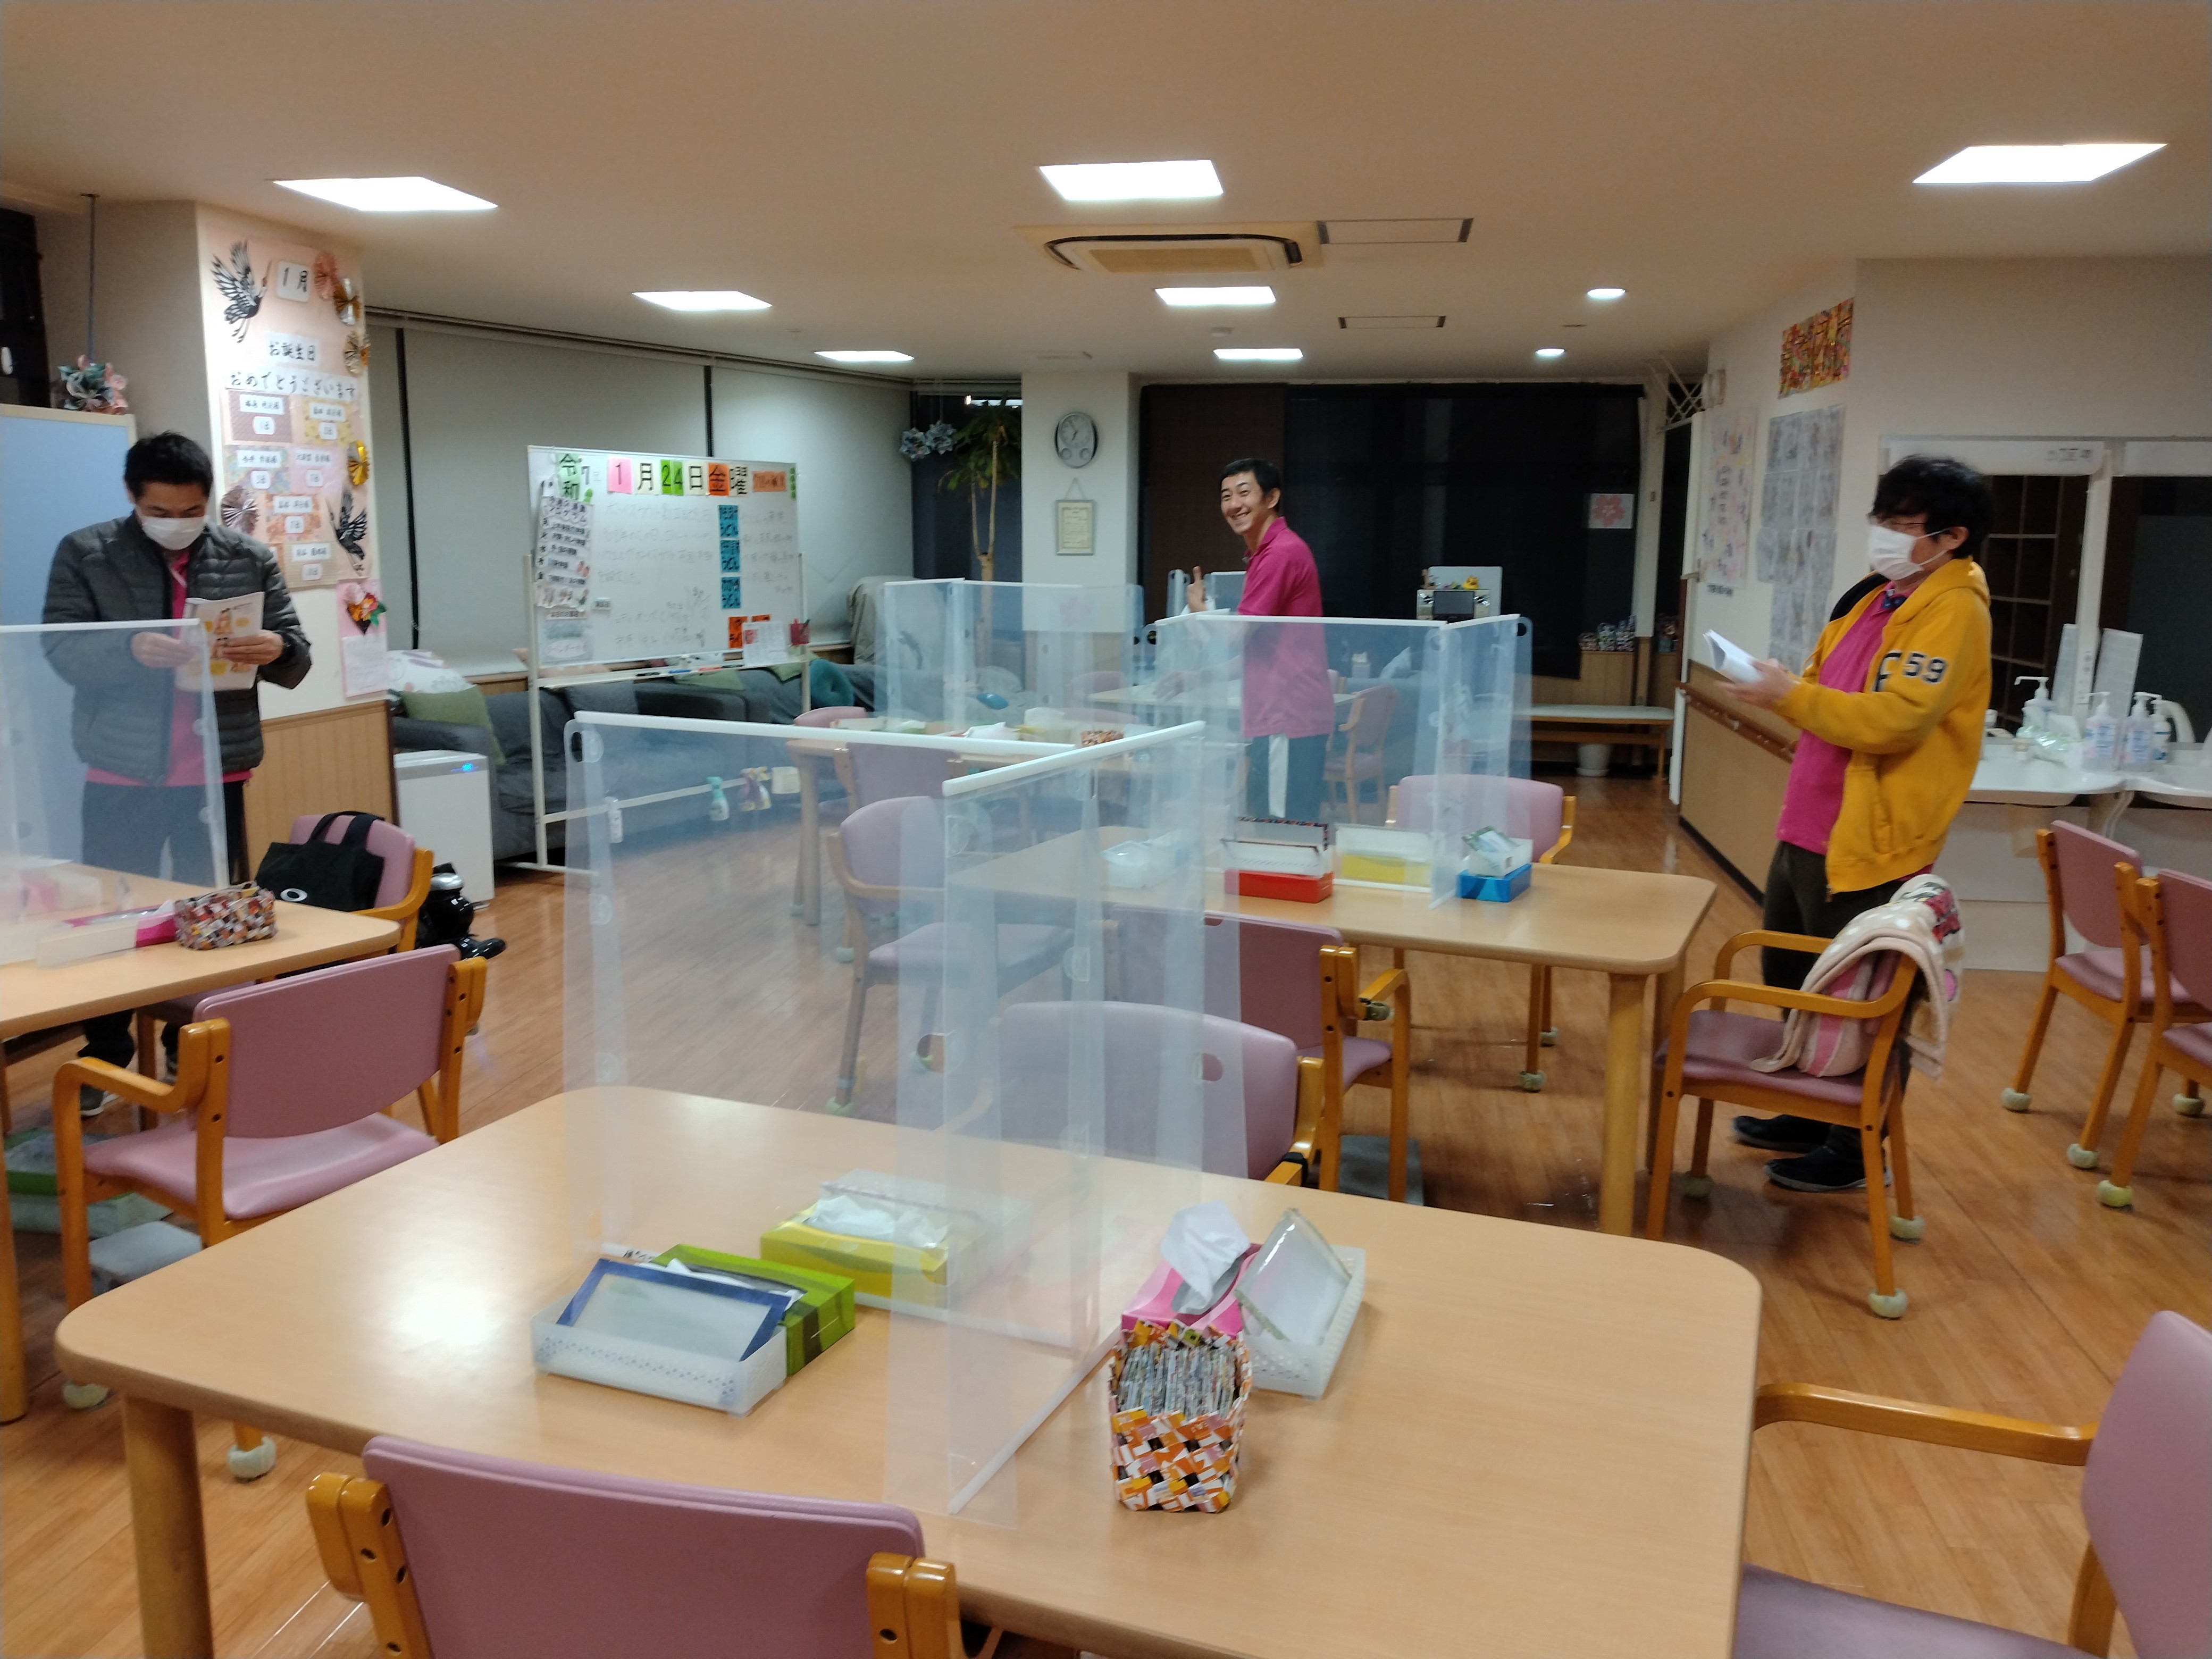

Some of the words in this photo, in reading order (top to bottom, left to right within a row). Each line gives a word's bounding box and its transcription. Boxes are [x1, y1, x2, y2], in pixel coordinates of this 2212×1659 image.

[282, 267, 308, 292] 1月
[269, 341, 316, 362] お誕生日
[230, 371, 356, 400] おめでとうございます
